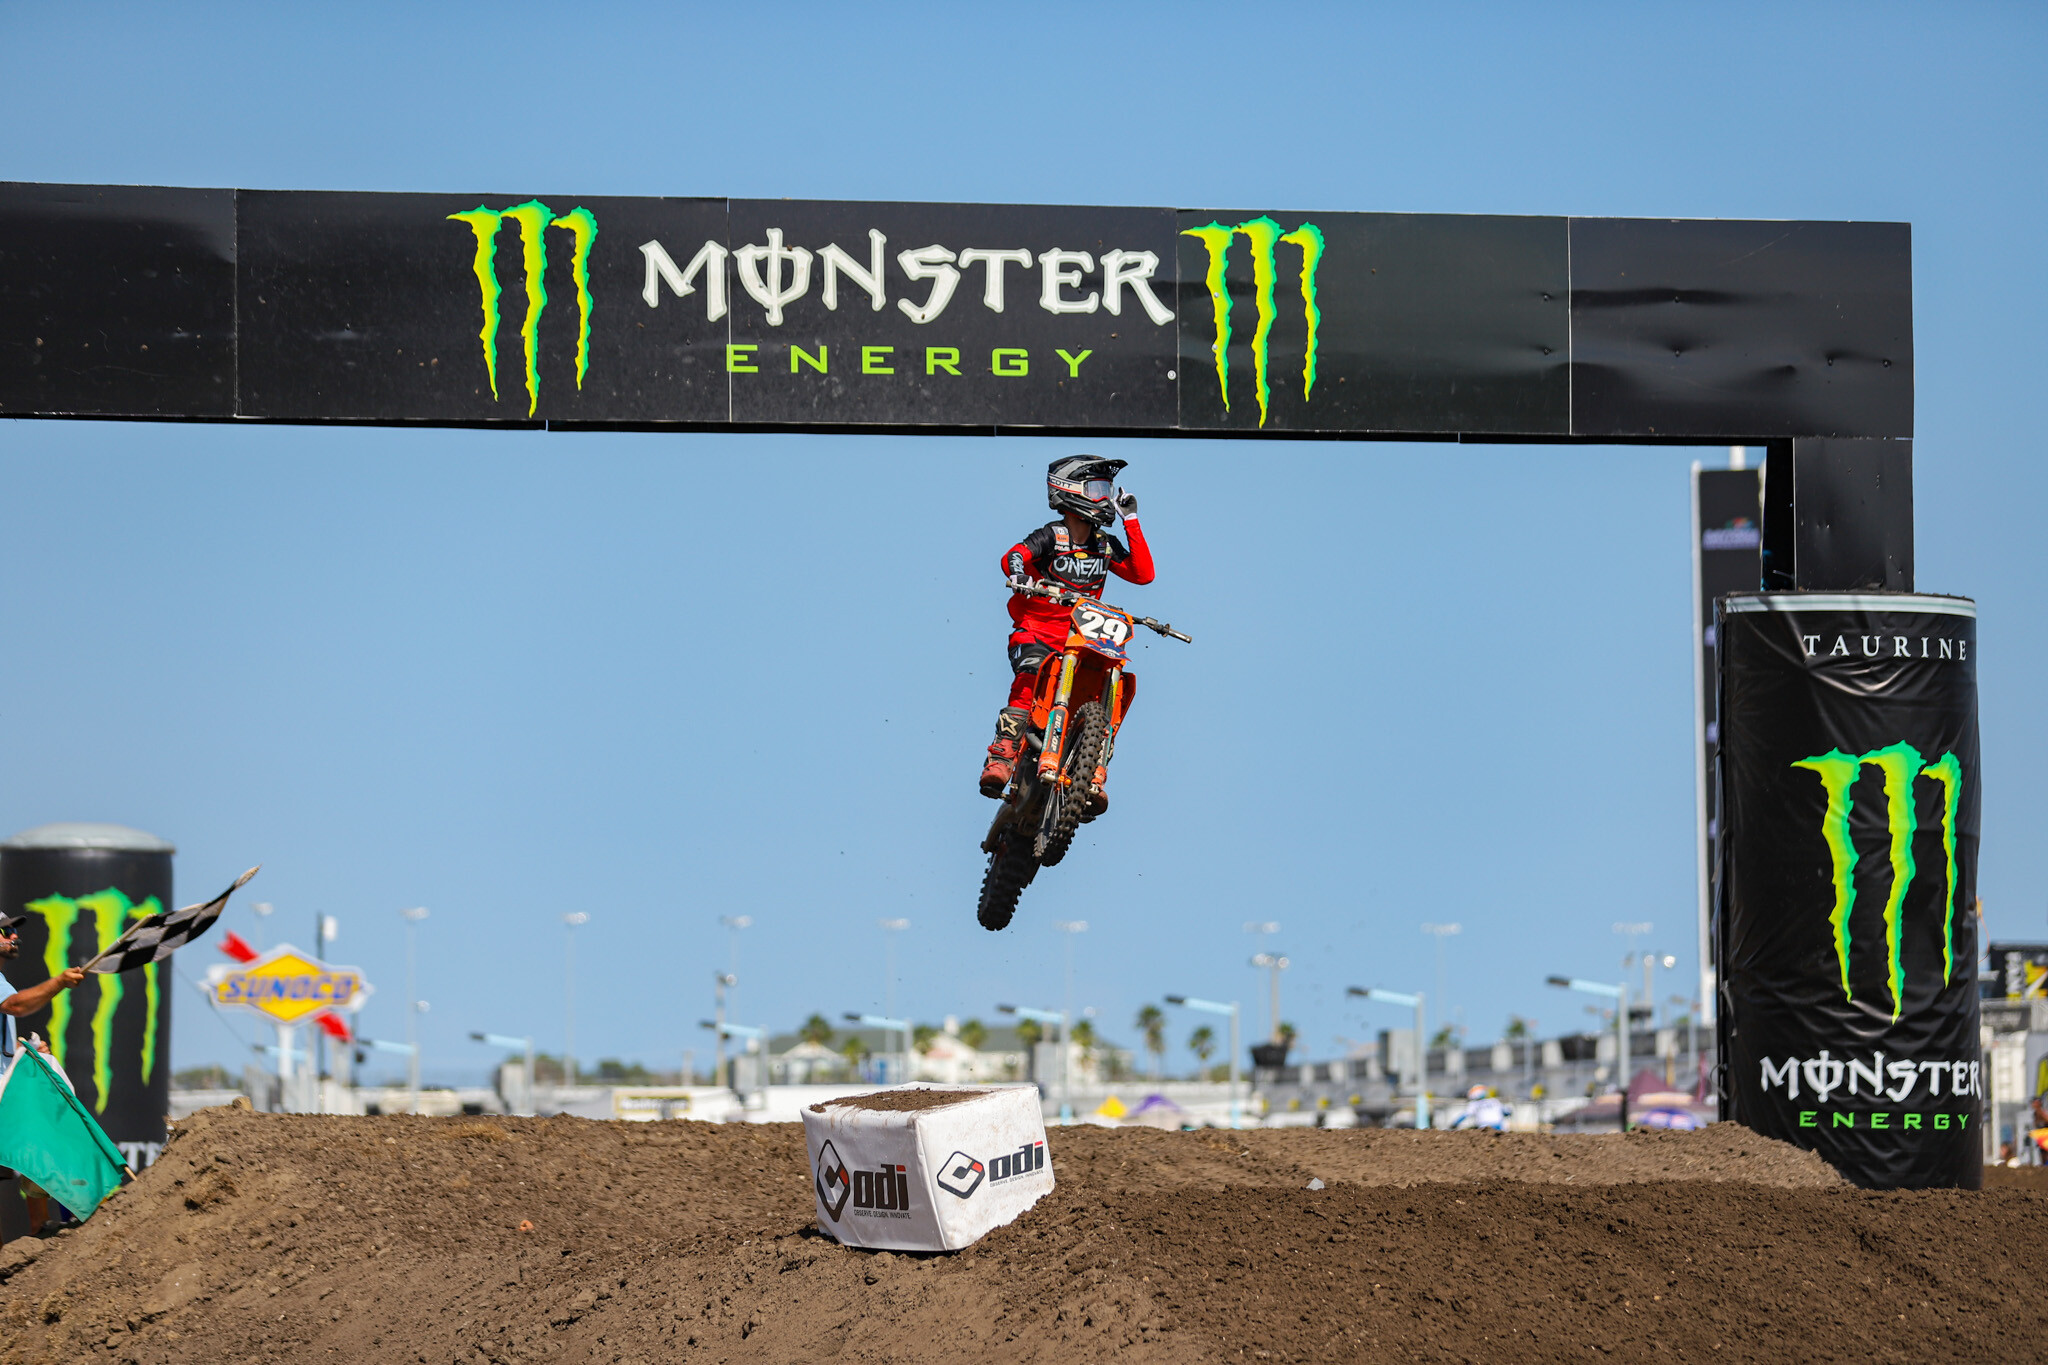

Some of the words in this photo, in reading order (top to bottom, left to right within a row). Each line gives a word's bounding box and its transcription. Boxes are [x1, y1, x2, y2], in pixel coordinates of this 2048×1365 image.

[639, 228, 1176, 326] MONSTER
[726, 344, 1093, 377] ENERGY
[1079, 611, 1128, 647] 29
[1802, 634, 1967, 661] TAURINE
[225, 975, 353, 999] SUNOCO
[1759, 1050, 1982, 1102] MONSTER
[1799, 1110, 1969, 1130] ENERGY
[989, 1140, 1044, 1182] odi
[853, 1164, 909, 1210] odi
